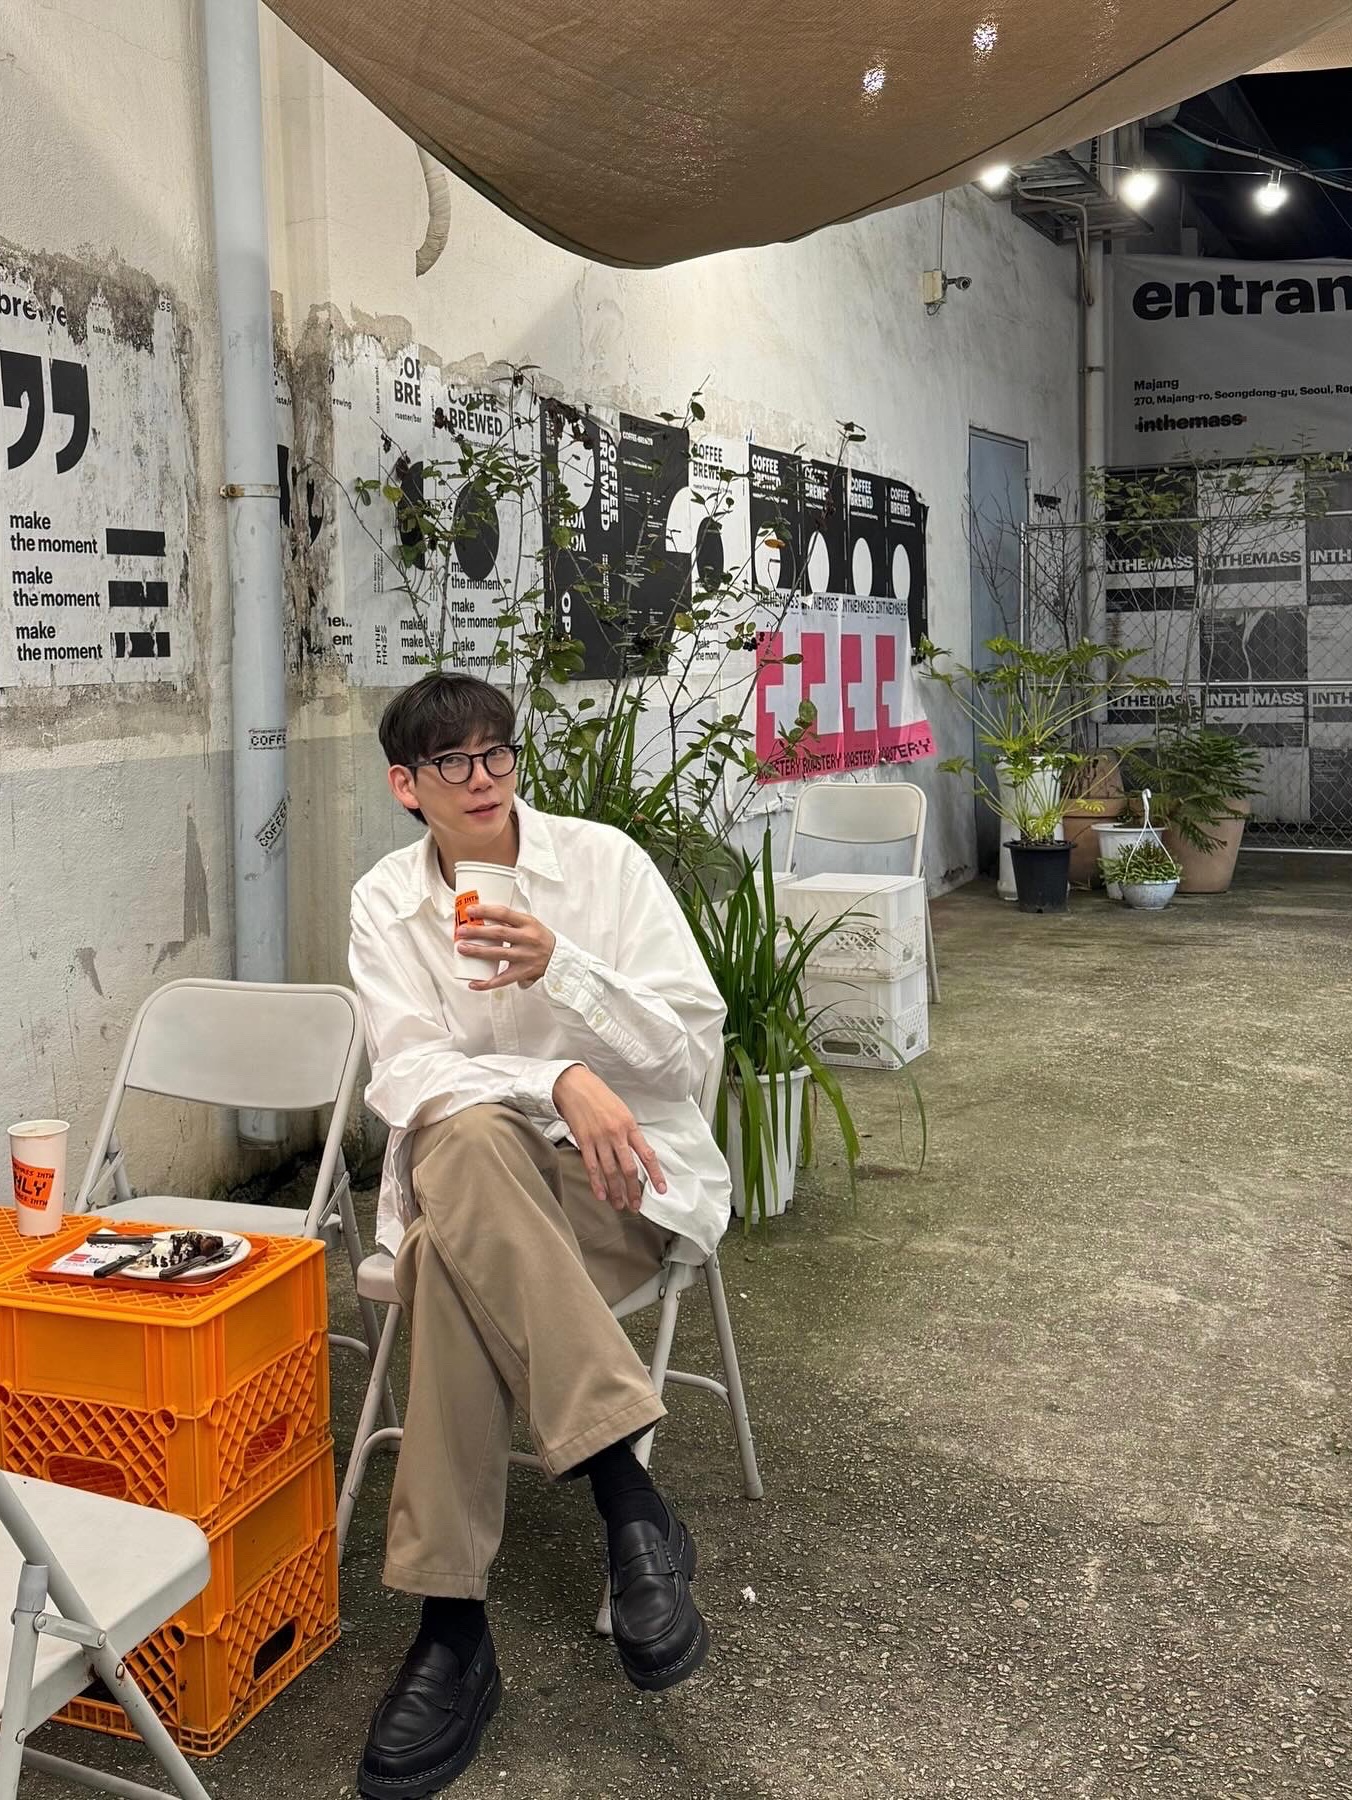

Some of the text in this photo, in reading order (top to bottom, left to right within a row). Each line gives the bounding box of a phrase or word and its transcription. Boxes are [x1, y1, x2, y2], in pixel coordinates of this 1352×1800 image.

[1134, 378, 1180, 391] Majang
[1134, 396, 1155, 407] 270,
[1157, 393, 1213, 405] Majang-ro,
[1214, 387, 1298, 400] Seongdong-gu,
[1300, 384, 1334, 395] Seoul,
[448, 407, 503, 437] BREWED
[1136, 413, 1244, 433] inthemass
[751, 454, 780, 475] COFFEE
[9, 511, 52, 530] make
[10, 532, 99, 554] the moment
[1105, 555, 1195, 574] NTHEMASS
[12, 565, 53, 585] make
[451, 574, 466, 589] the
[13, 588, 101, 607] the moment
[451, 597, 475, 613] make
[16, 620, 56, 640] make
[451, 613, 498, 629] the momen
[401, 633, 424, 648] make
[452, 636, 475, 652] make
[17, 643, 103, 662] the moment
[1107, 691, 1196, 709] NTHEMASS
